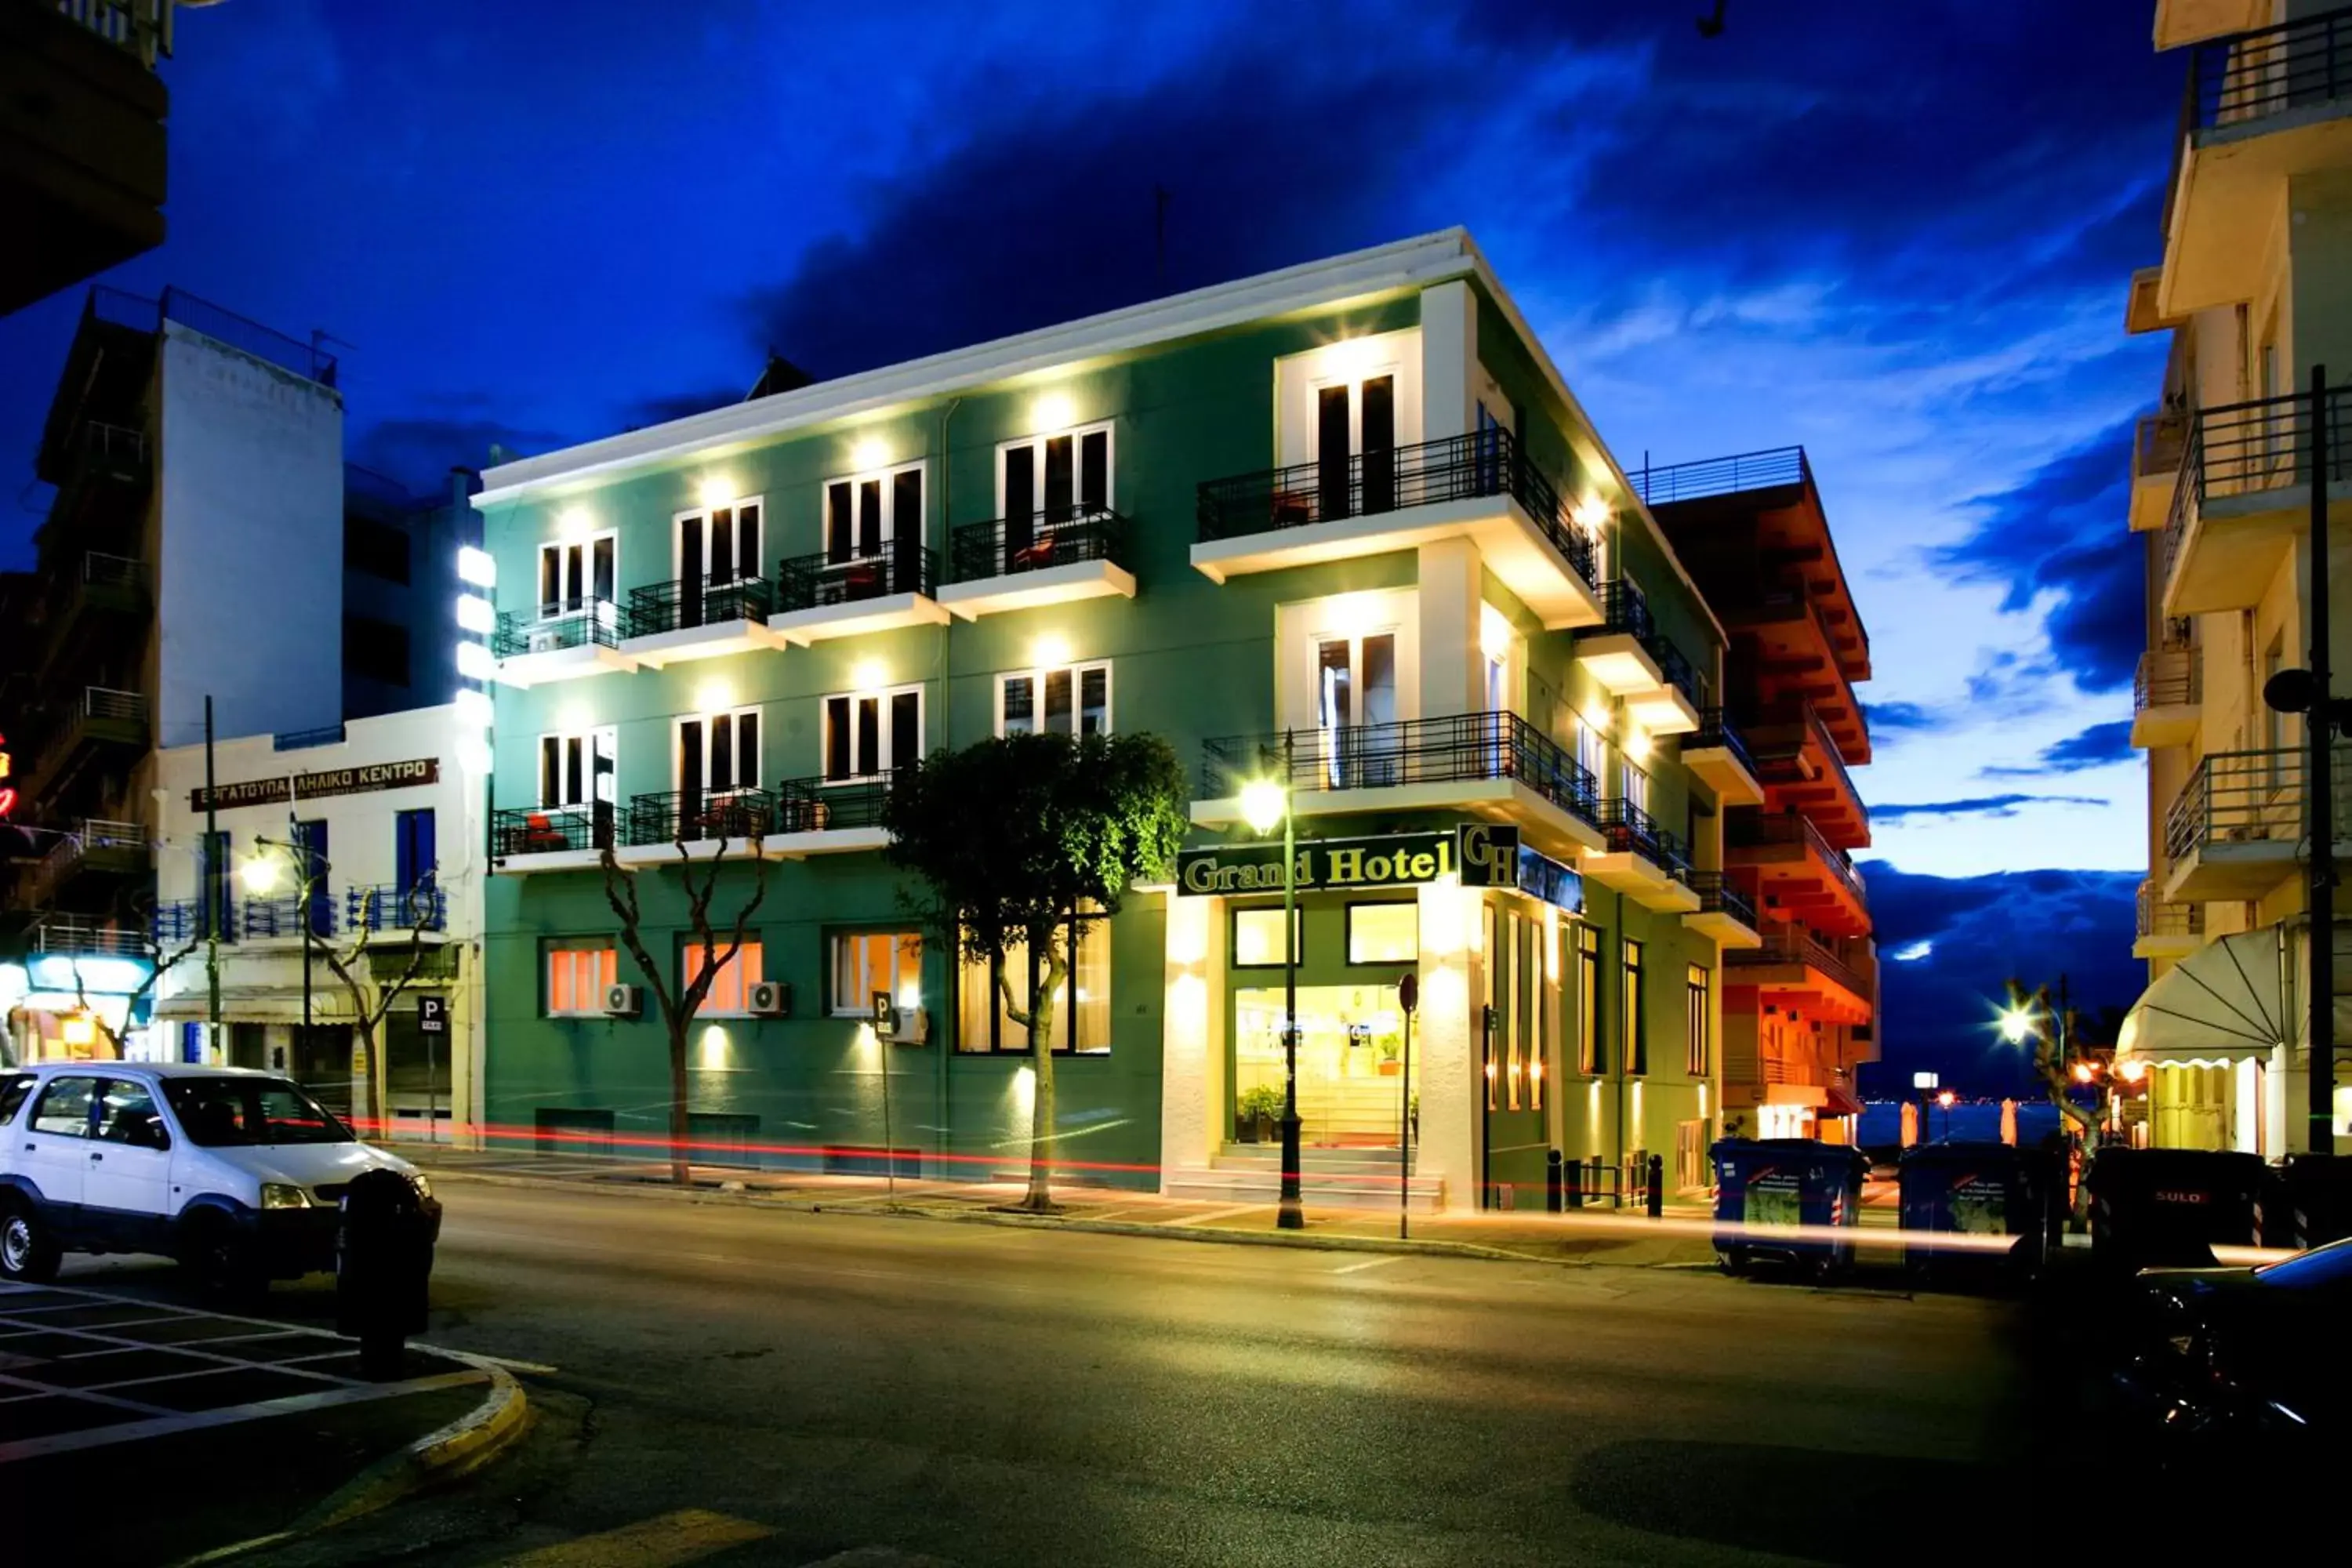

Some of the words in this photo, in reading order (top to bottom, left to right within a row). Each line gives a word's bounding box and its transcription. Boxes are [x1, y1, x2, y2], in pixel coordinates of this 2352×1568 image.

[358, 761, 426, 784] ΚΕΝΤΡΟ
[1185, 850, 1315, 893] Grand
[1326, 840, 1450, 884] Hotel
[1463, 825, 1517, 887] GH
[425, 1000, 438, 1018] P
[877, 997, 889, 1018] P
[2154, 1190, 2201, 1203] SULO
